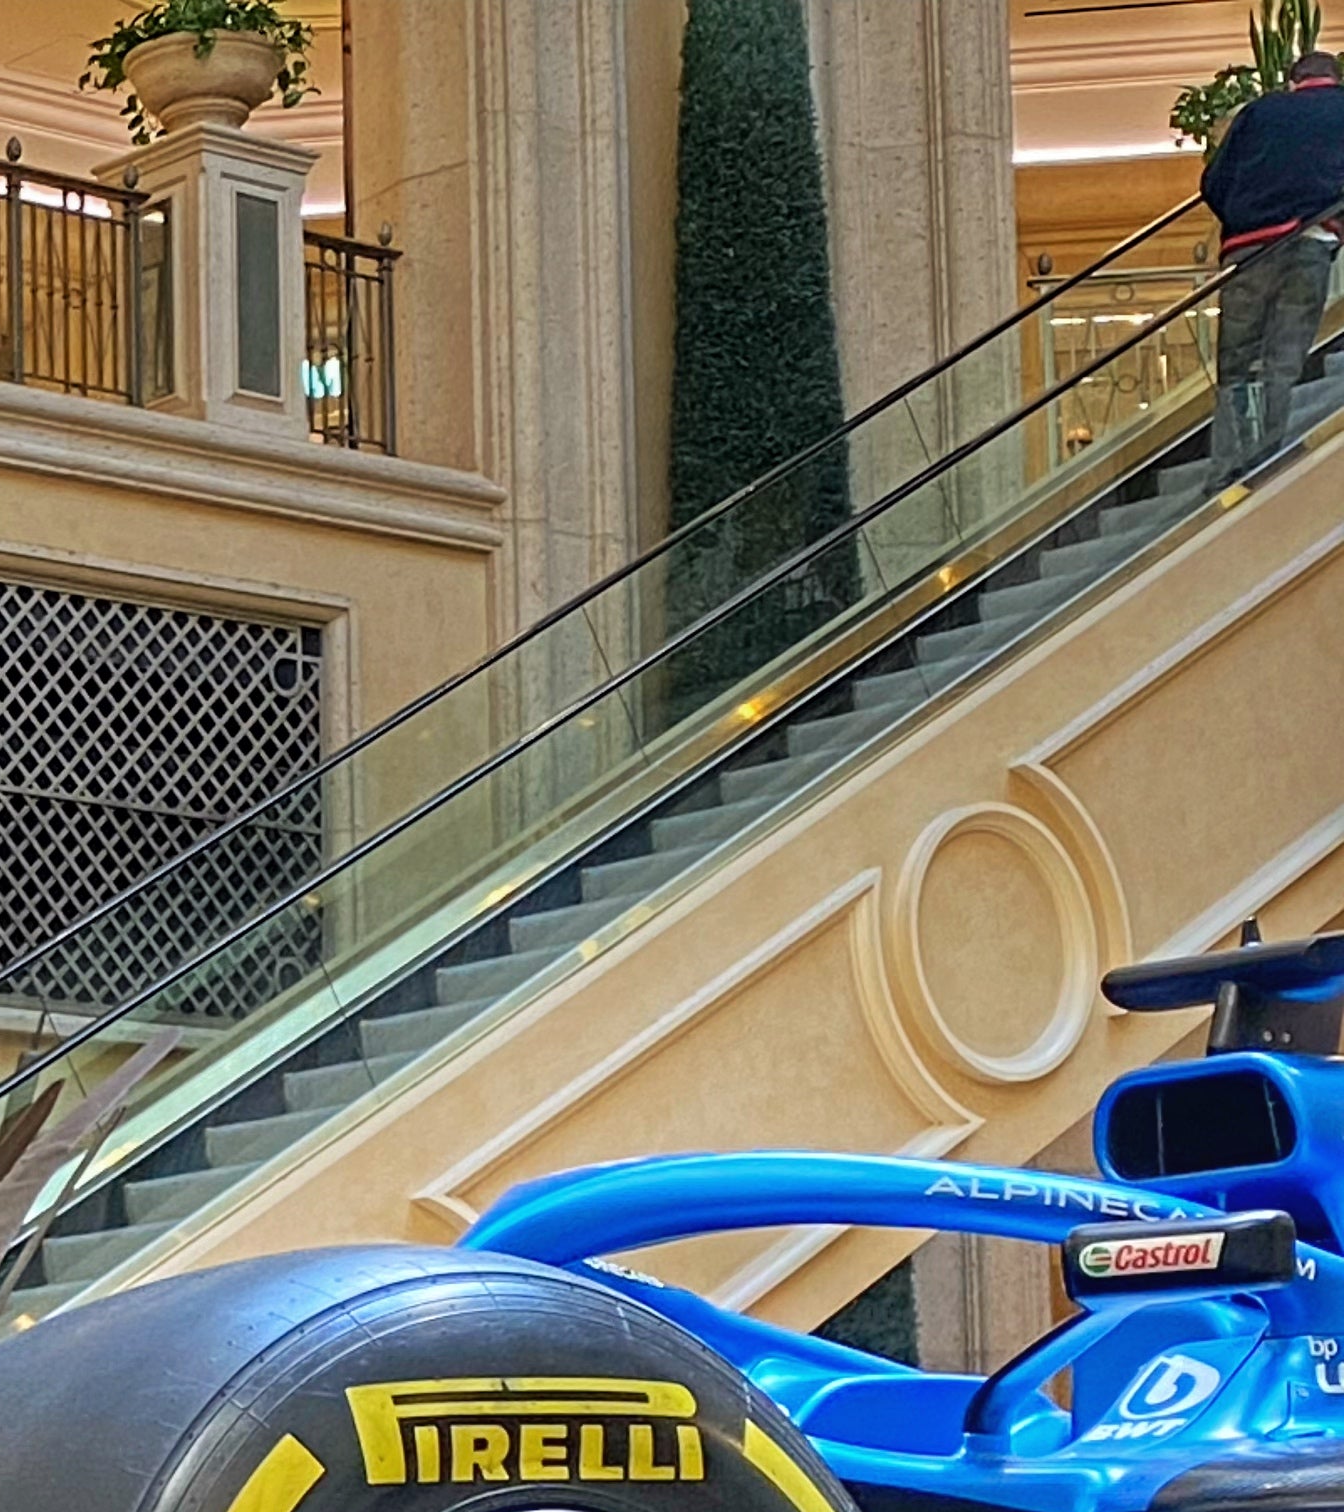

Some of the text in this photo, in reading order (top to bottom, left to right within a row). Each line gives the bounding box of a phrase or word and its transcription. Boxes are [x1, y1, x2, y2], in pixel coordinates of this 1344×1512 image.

[1114, 1238, 1211, 1271] Castrol
[1308, 1335, 1338, 1361] bp
[346, 1376, 705, 1485] PIRELLI
[1081, 1418, 1188, 1442] BWT
